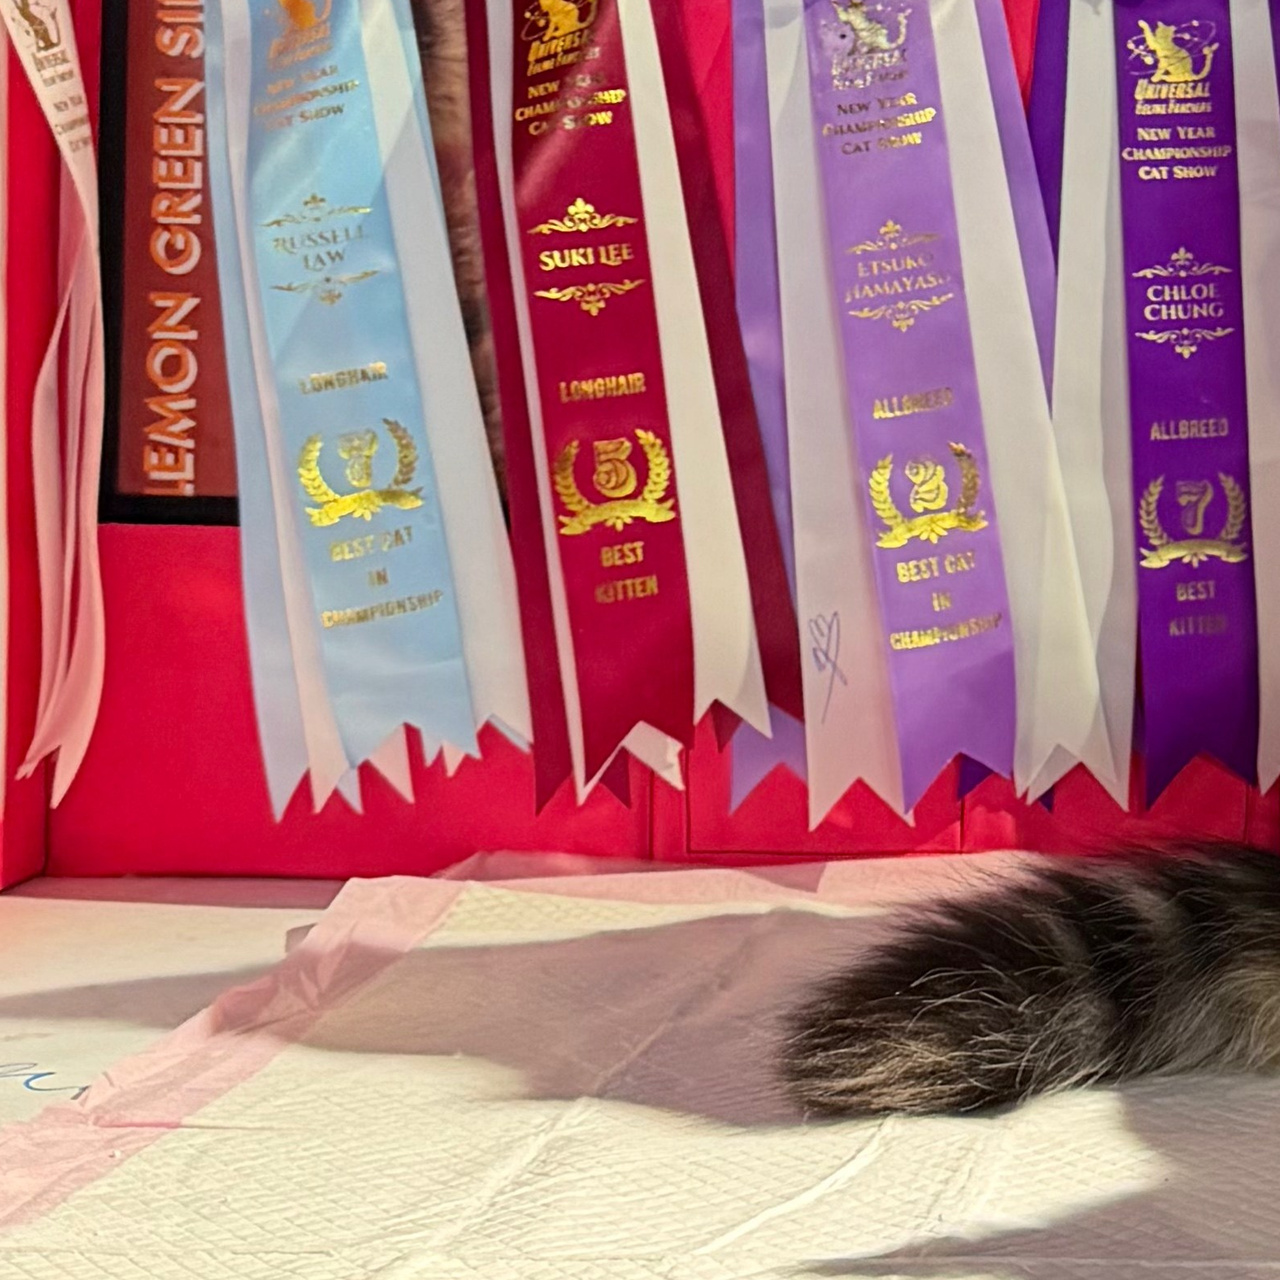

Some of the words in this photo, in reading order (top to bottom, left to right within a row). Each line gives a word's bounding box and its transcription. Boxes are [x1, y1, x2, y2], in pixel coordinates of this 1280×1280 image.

[1134, 78, 1211, 101] UNIVERSAL
[299, 103, 346, 123] SHOW
[836, 102, 872, 116] NEW
[1137, 127, 1172, 142] NEW
[1176, 126, 1217, 140] YEAR
[840, 140, 872, 155] CAT
[1121, 144, 1233, 161] CHAMPIONSHIP
[151, 77, 205, 275] GREEN
[1137, 165, 1170, 181] CAT
[1172, 164, 1217, 180] SHOW
[302, 249, 346, 271] LAW
[538, 245, 595, 272] SUKI
[598, 243, 635, 267] LEE
[1146, 282, 1220, 303] CHLOE
[1143, 301, 1225, 322] CHUNG
[300, 361, 389, 394] LONGHAIR
[559, 372, 647, 403] LONGHAIR
[142, 290, 201, 497] LEMON
[1150, 417, 1230, 441] ALLBREED
[592, 438, 638, 498] 5
[1175, 479, 1215, 536] 7
[328, 534, 376, 563] BEST
[380, 525, 414, 553] CAT
[599, 541, 645, 568] BEST
[896, 556, 940, 584] BEST
[943, 551, 977, 575] CAT
[594, 575, 659, 604] KITTEN
[932, 592, 951, 612] IN
[1176, 580, 1217, 602] BEST
[320, 589, 444, 629] CHAMPIONSHIP
[888, 612, 1003, 651] CHAMPIONSHIP
